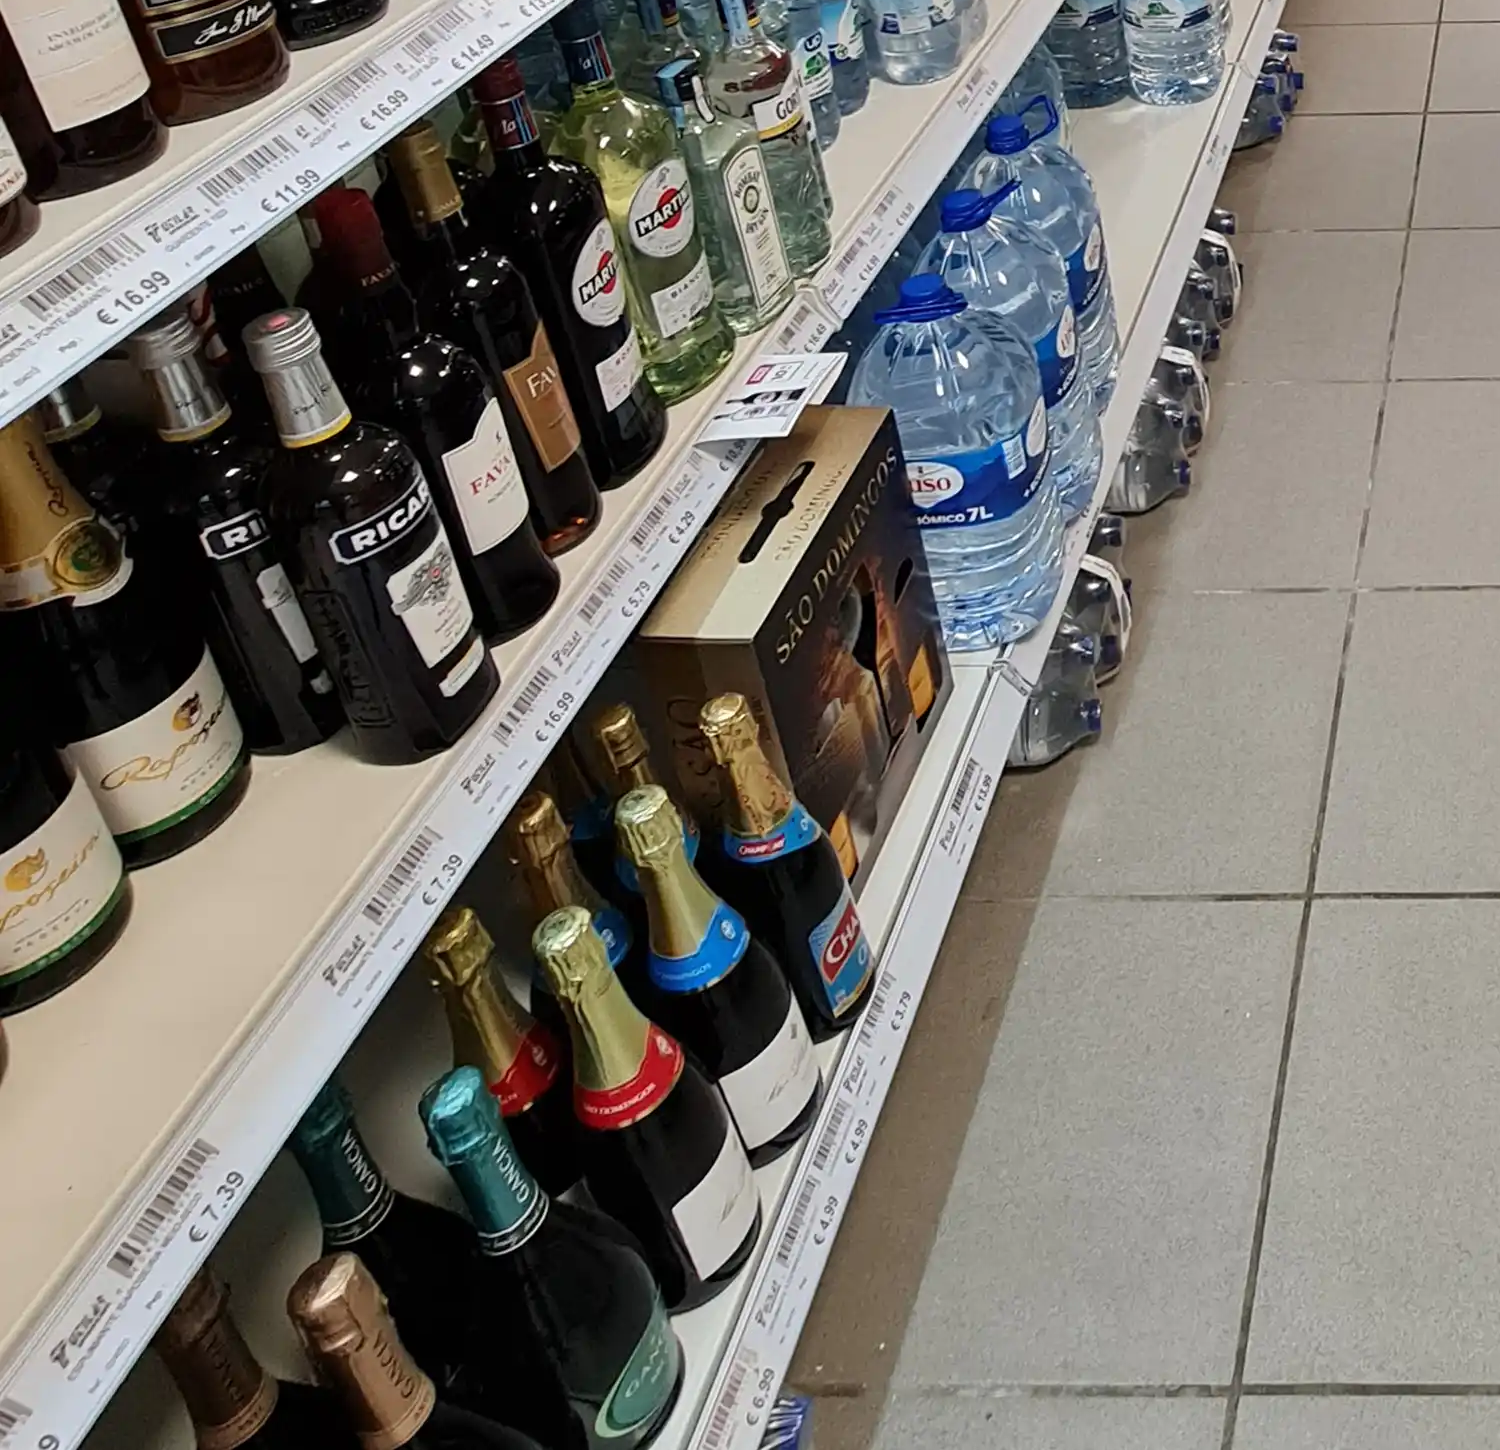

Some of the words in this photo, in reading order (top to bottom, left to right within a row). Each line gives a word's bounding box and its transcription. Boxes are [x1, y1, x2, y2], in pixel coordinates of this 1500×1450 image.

[360, 115, 376, 131] €
[371, 89, 409, 121] 16.99
[260, 198, 278, 213] €
[97, 308, 117, 327] €
[114, 270, 172, 314] 16.99
[967, 506, 994, 521] 7L
[775, 596, 816, 664] SÃO
[814, 446, 899, 599] DOMINGOS
[632, 582, 651, 609] 5.79
[535, 730, 549, 743] €
[543, 692, 574, 732] 16.99
[422, 892, 437, 907] €
[436, 853, 464, 891] 7.39
[897, 990, 912, 1020] 3.79
[852, 1119, 868, 1150] 4.99
[340, 1128, 377, 1195] GANCIA
[491, 1134, 530, 1204] GANCIA
[188, 1225, 209, 1243] €
[200, 1170, 245, 1222] 7.39
[820, 1196, 841, 1232] 4.99
[371, 1329, 416, 1400] GANCIA
[746, 1412, 757, 1427] €
[752, 1367, 775, 1408] 6.99
